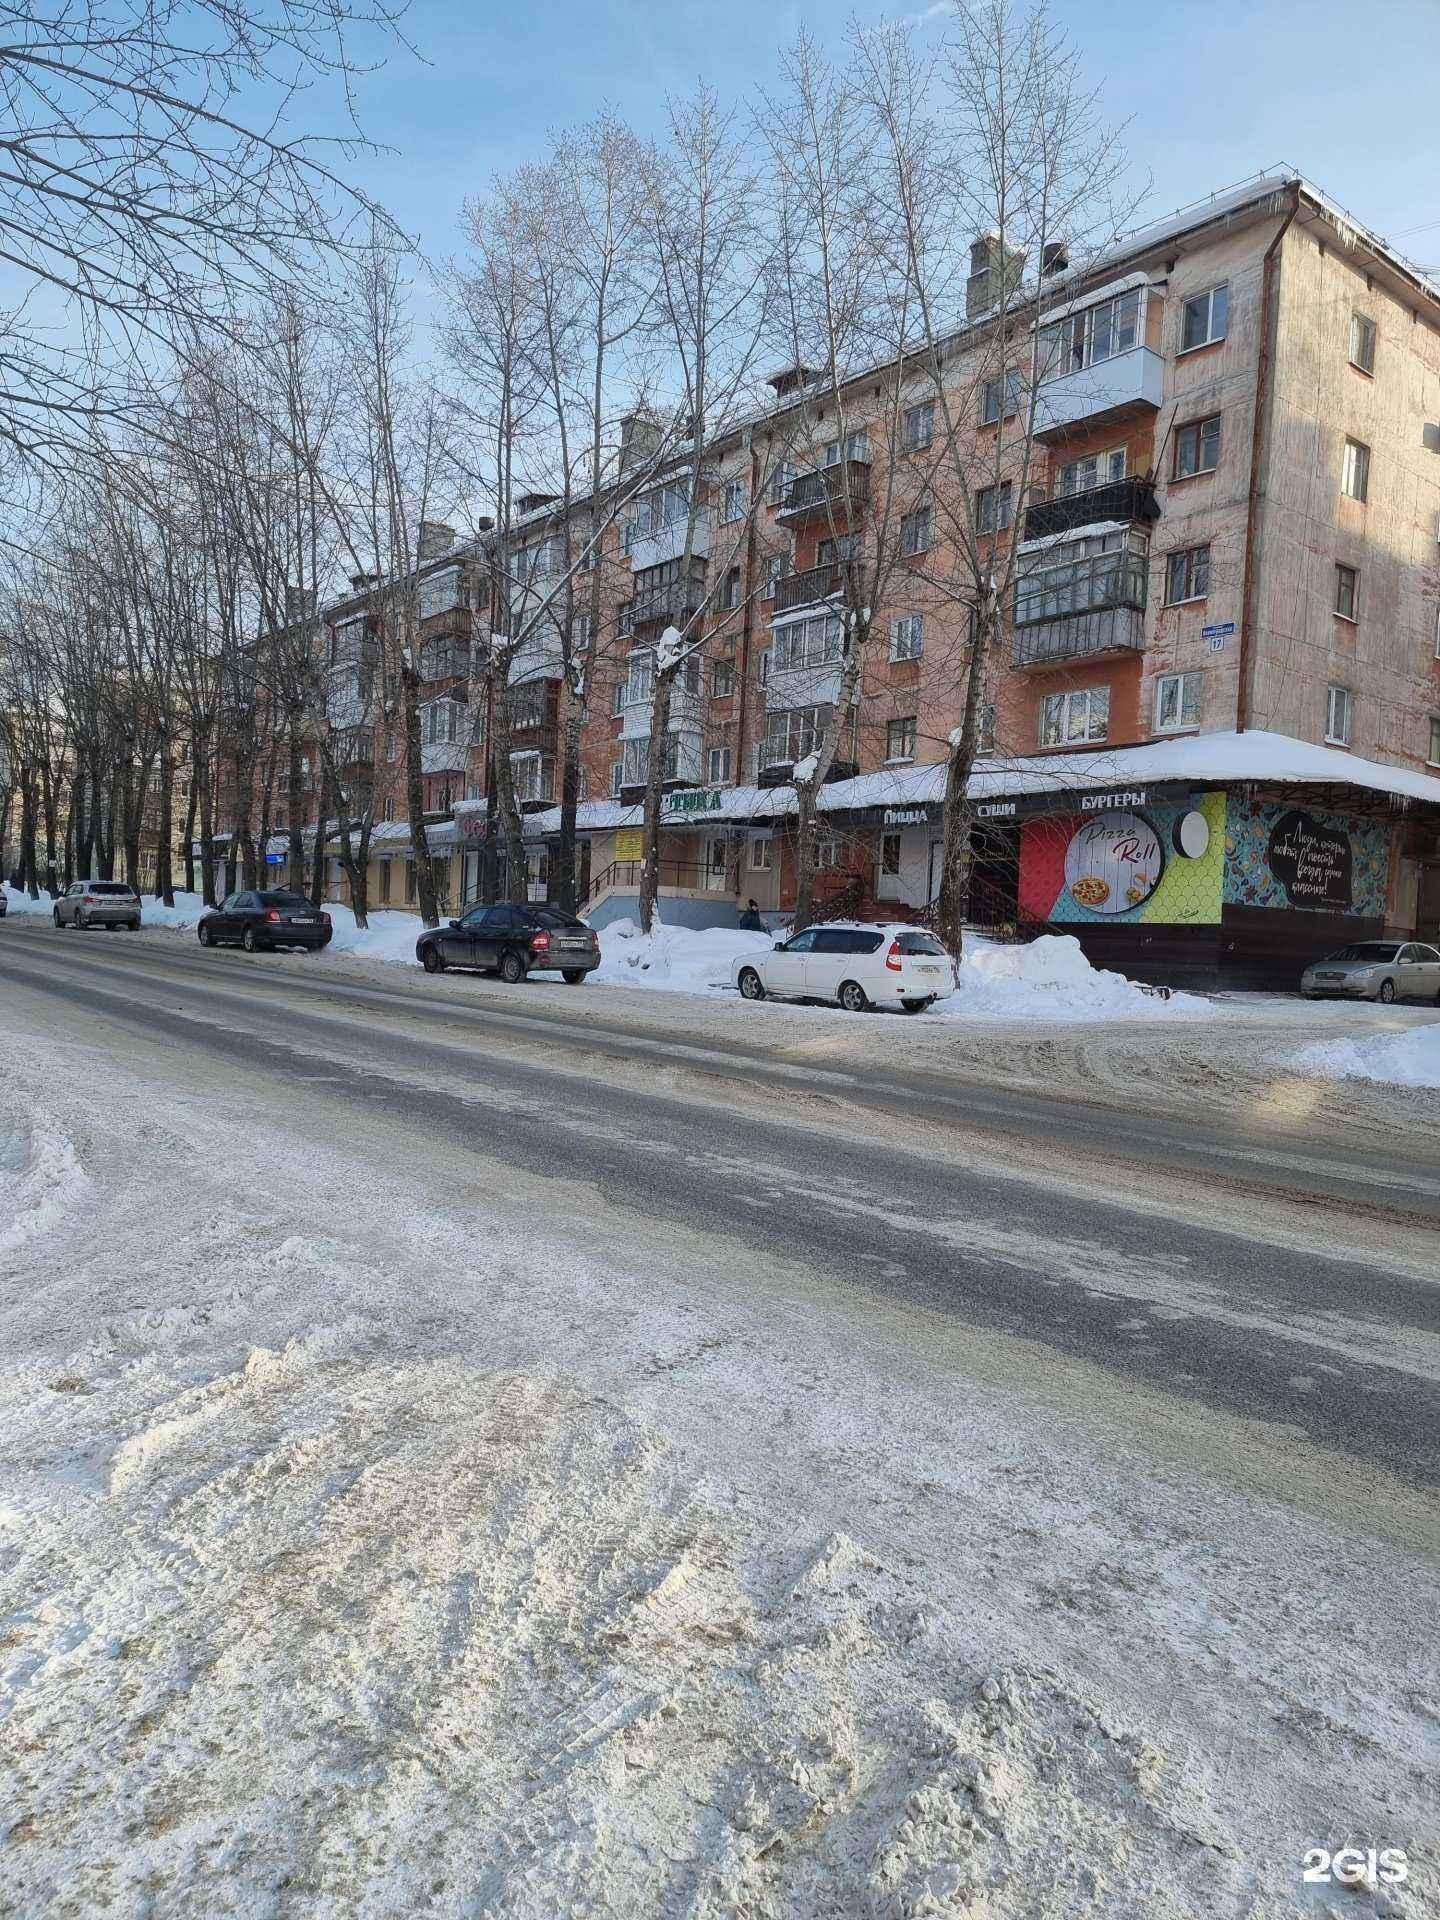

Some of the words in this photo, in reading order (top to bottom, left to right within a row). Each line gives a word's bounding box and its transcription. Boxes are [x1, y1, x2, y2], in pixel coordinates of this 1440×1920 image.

[1213, 639, 1222, 649] 17
[1081, 792, 1146, 809] БУРГЕРЫ
[884, 809, 928, 824] ПИЦЦА
[1080, 822, 1136, 844] Pizza
[1113, 837, 1156, 864] Roll
